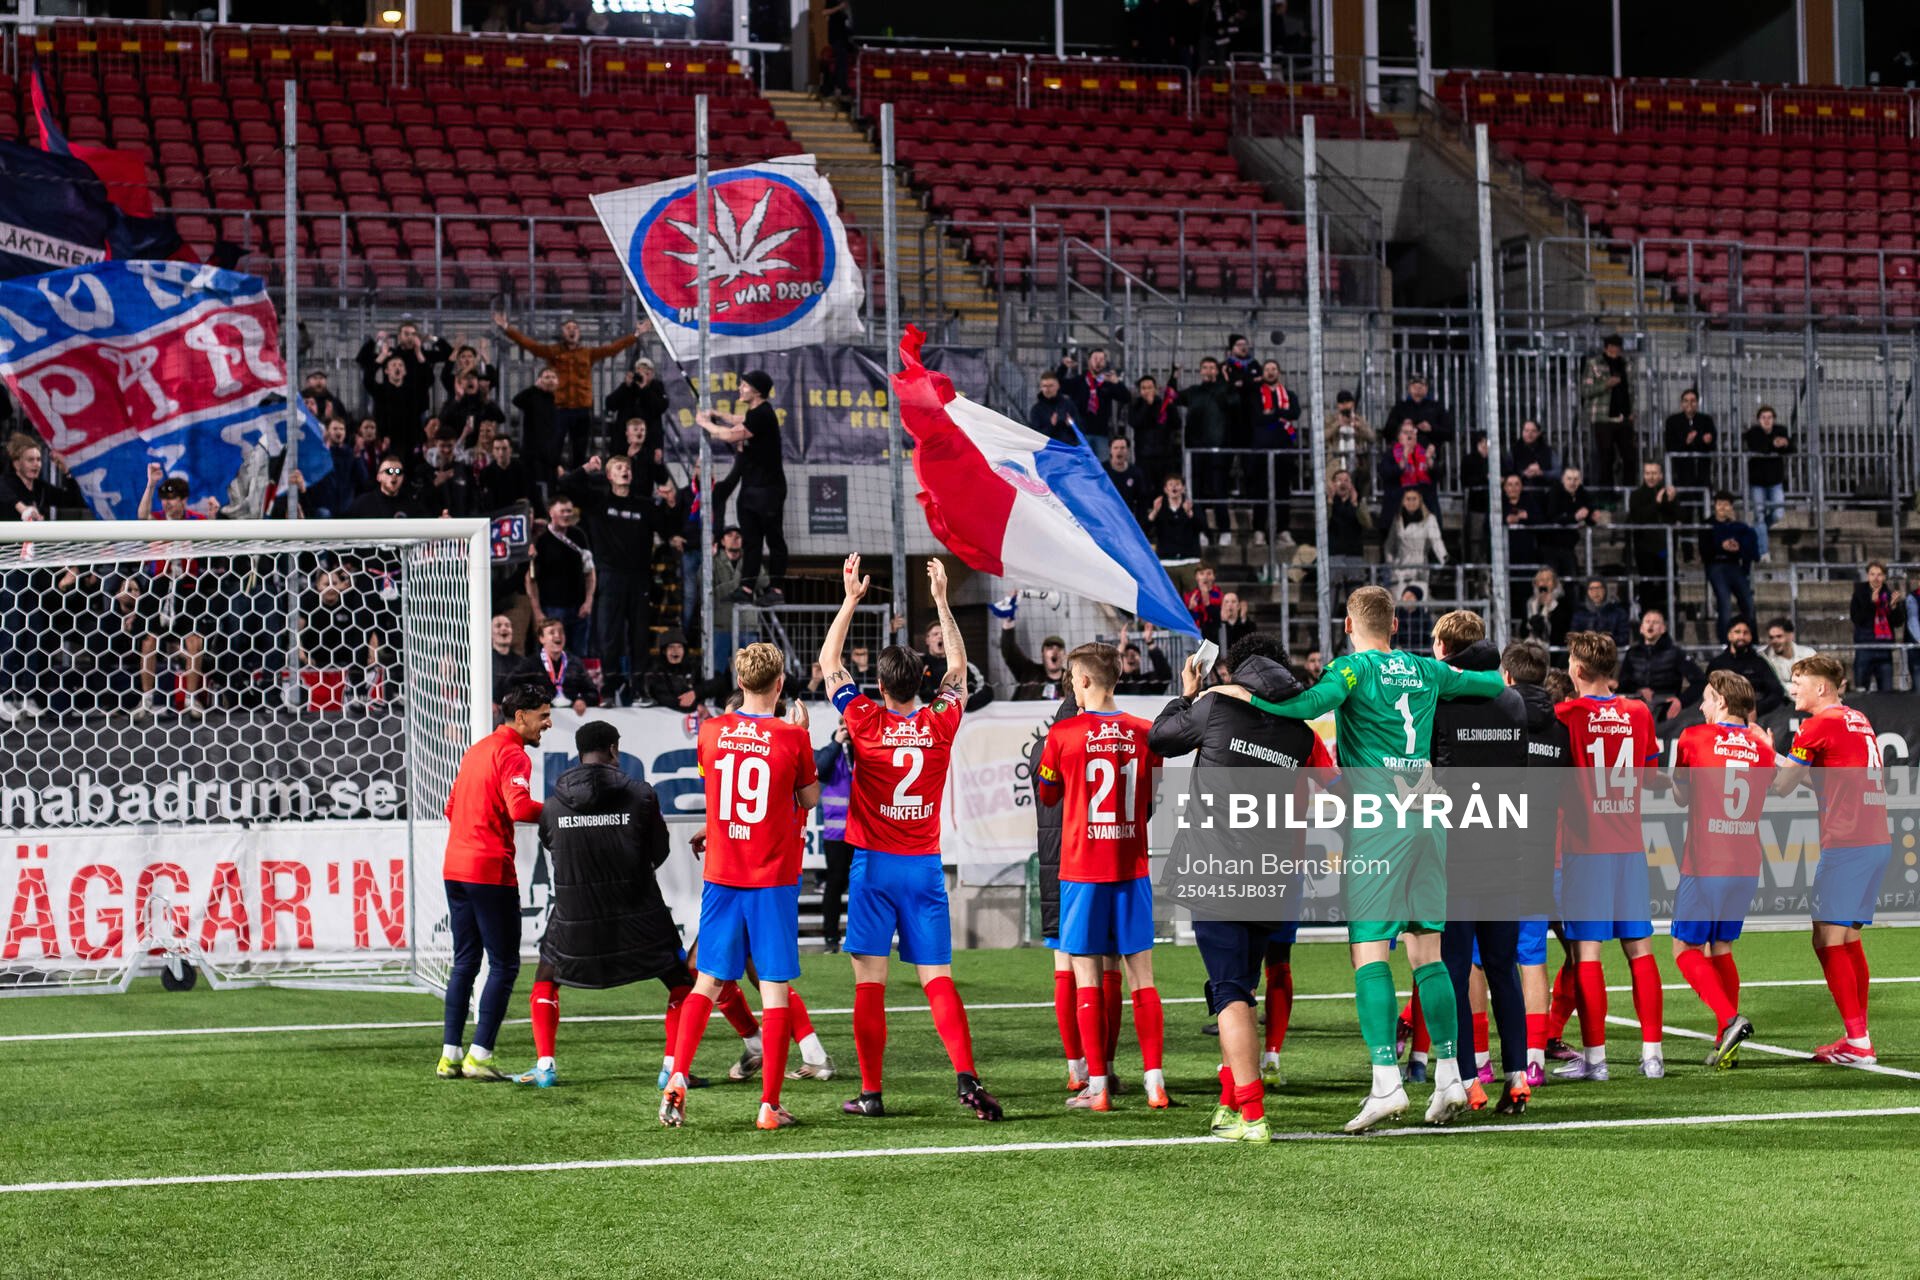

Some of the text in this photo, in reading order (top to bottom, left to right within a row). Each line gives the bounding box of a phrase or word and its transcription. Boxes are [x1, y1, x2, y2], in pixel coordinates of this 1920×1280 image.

[776, 281, 824, 300] DROG
[1394, 692, 1417, 755] 1
[1588, 722, 1632, 735] letusplay
[882, 735, 933, 747] letusplay
[1457, 728, 1521, 742] HELSINGBORGS IF
[717, 738, 770, 756] letusplay
[1086, 743, 1136, 754] letusplay
[1229, 737, 1299, 771] HELSINGBORGS IF
[1528, 742, 1561, 759] BORGS IF
[1714, 744, 1759, 763] letusplay
[892, 747, 924, 806] 2
[1586, 737, 1637, 798] 14
[714, 753, 771, 824] 19
[1087, 758, 1138, 822] 21
[1723, 759, 1750, 820] 5
[558, 813, 631, 828] HELSINGBORGS IF
[728, 822, 750, 840] ÖRN
